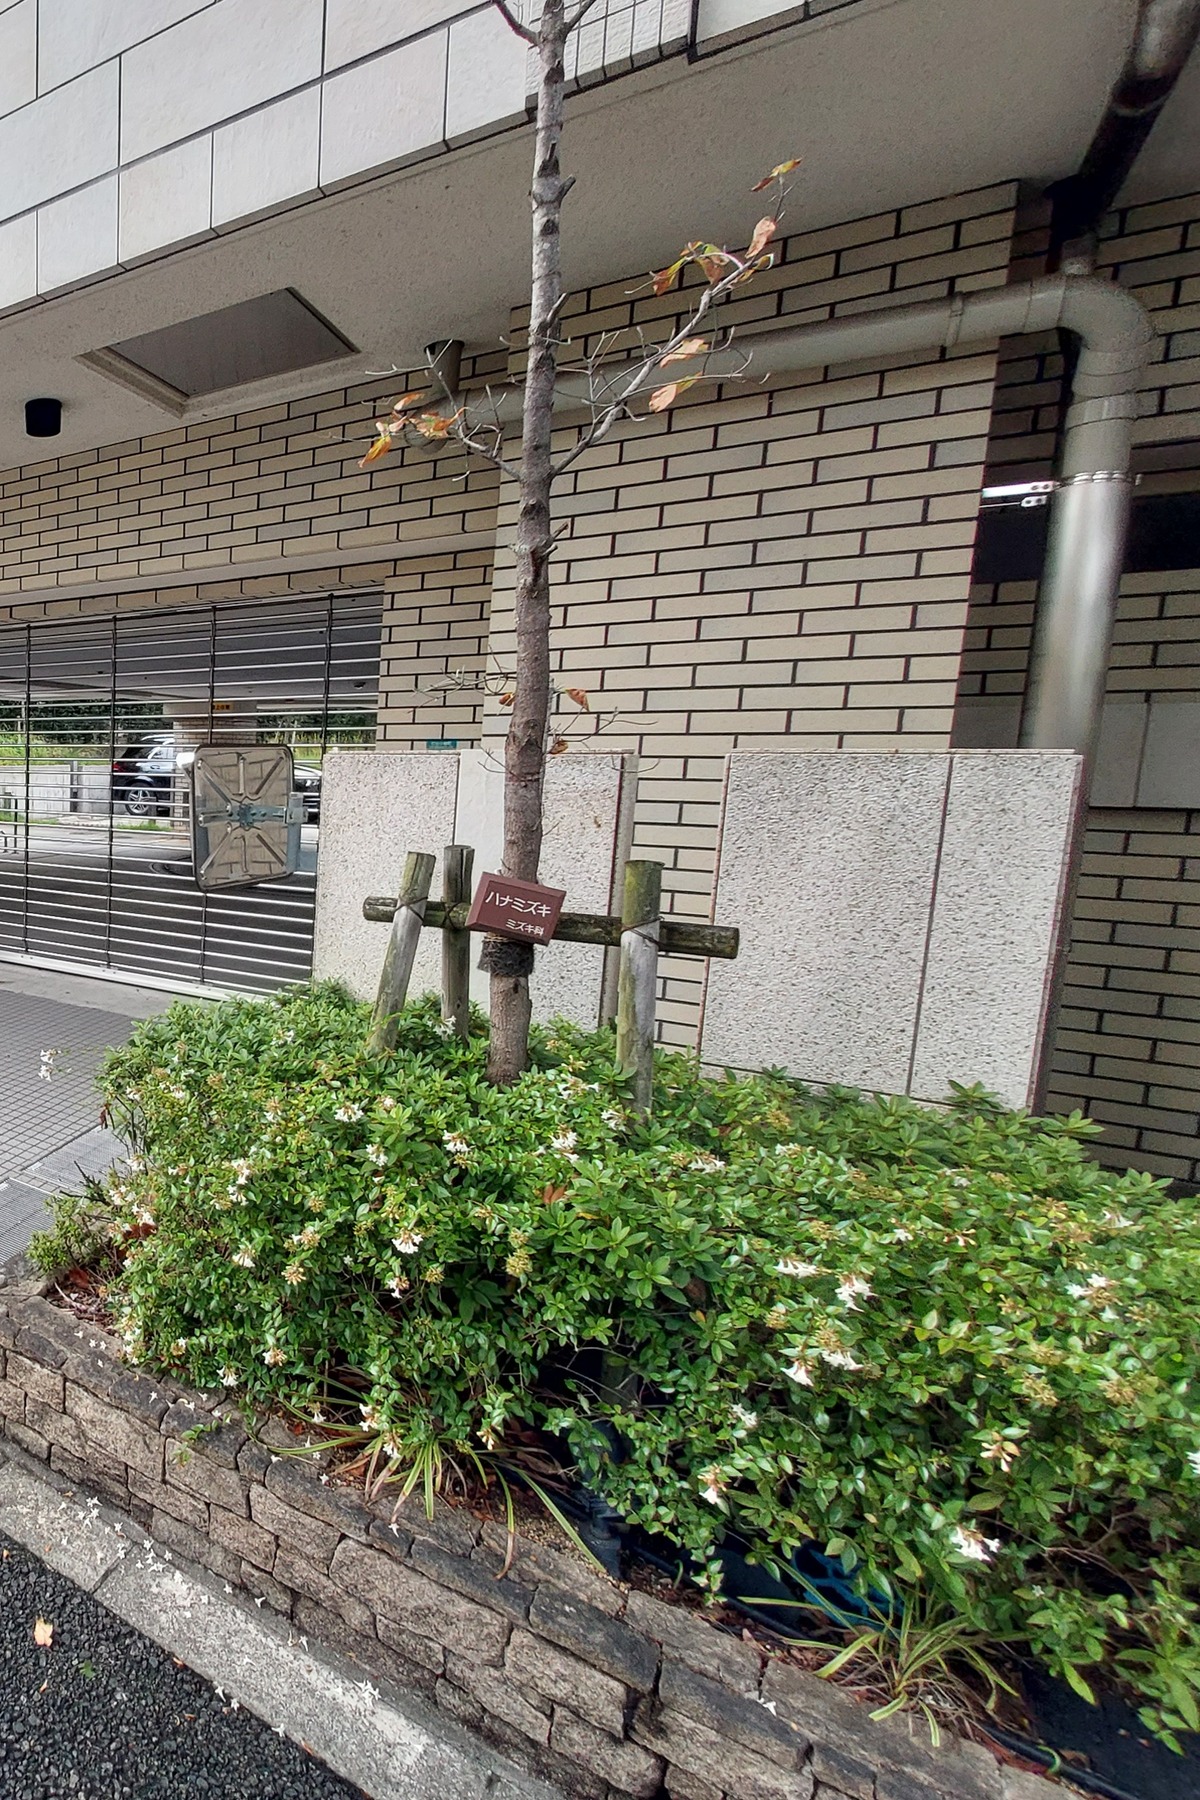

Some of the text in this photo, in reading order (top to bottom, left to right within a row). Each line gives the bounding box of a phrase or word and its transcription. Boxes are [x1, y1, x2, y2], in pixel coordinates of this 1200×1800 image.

[485, 891, 552, 918] ハナミズキ
[505, 918, 545, 937] ミズキ科
